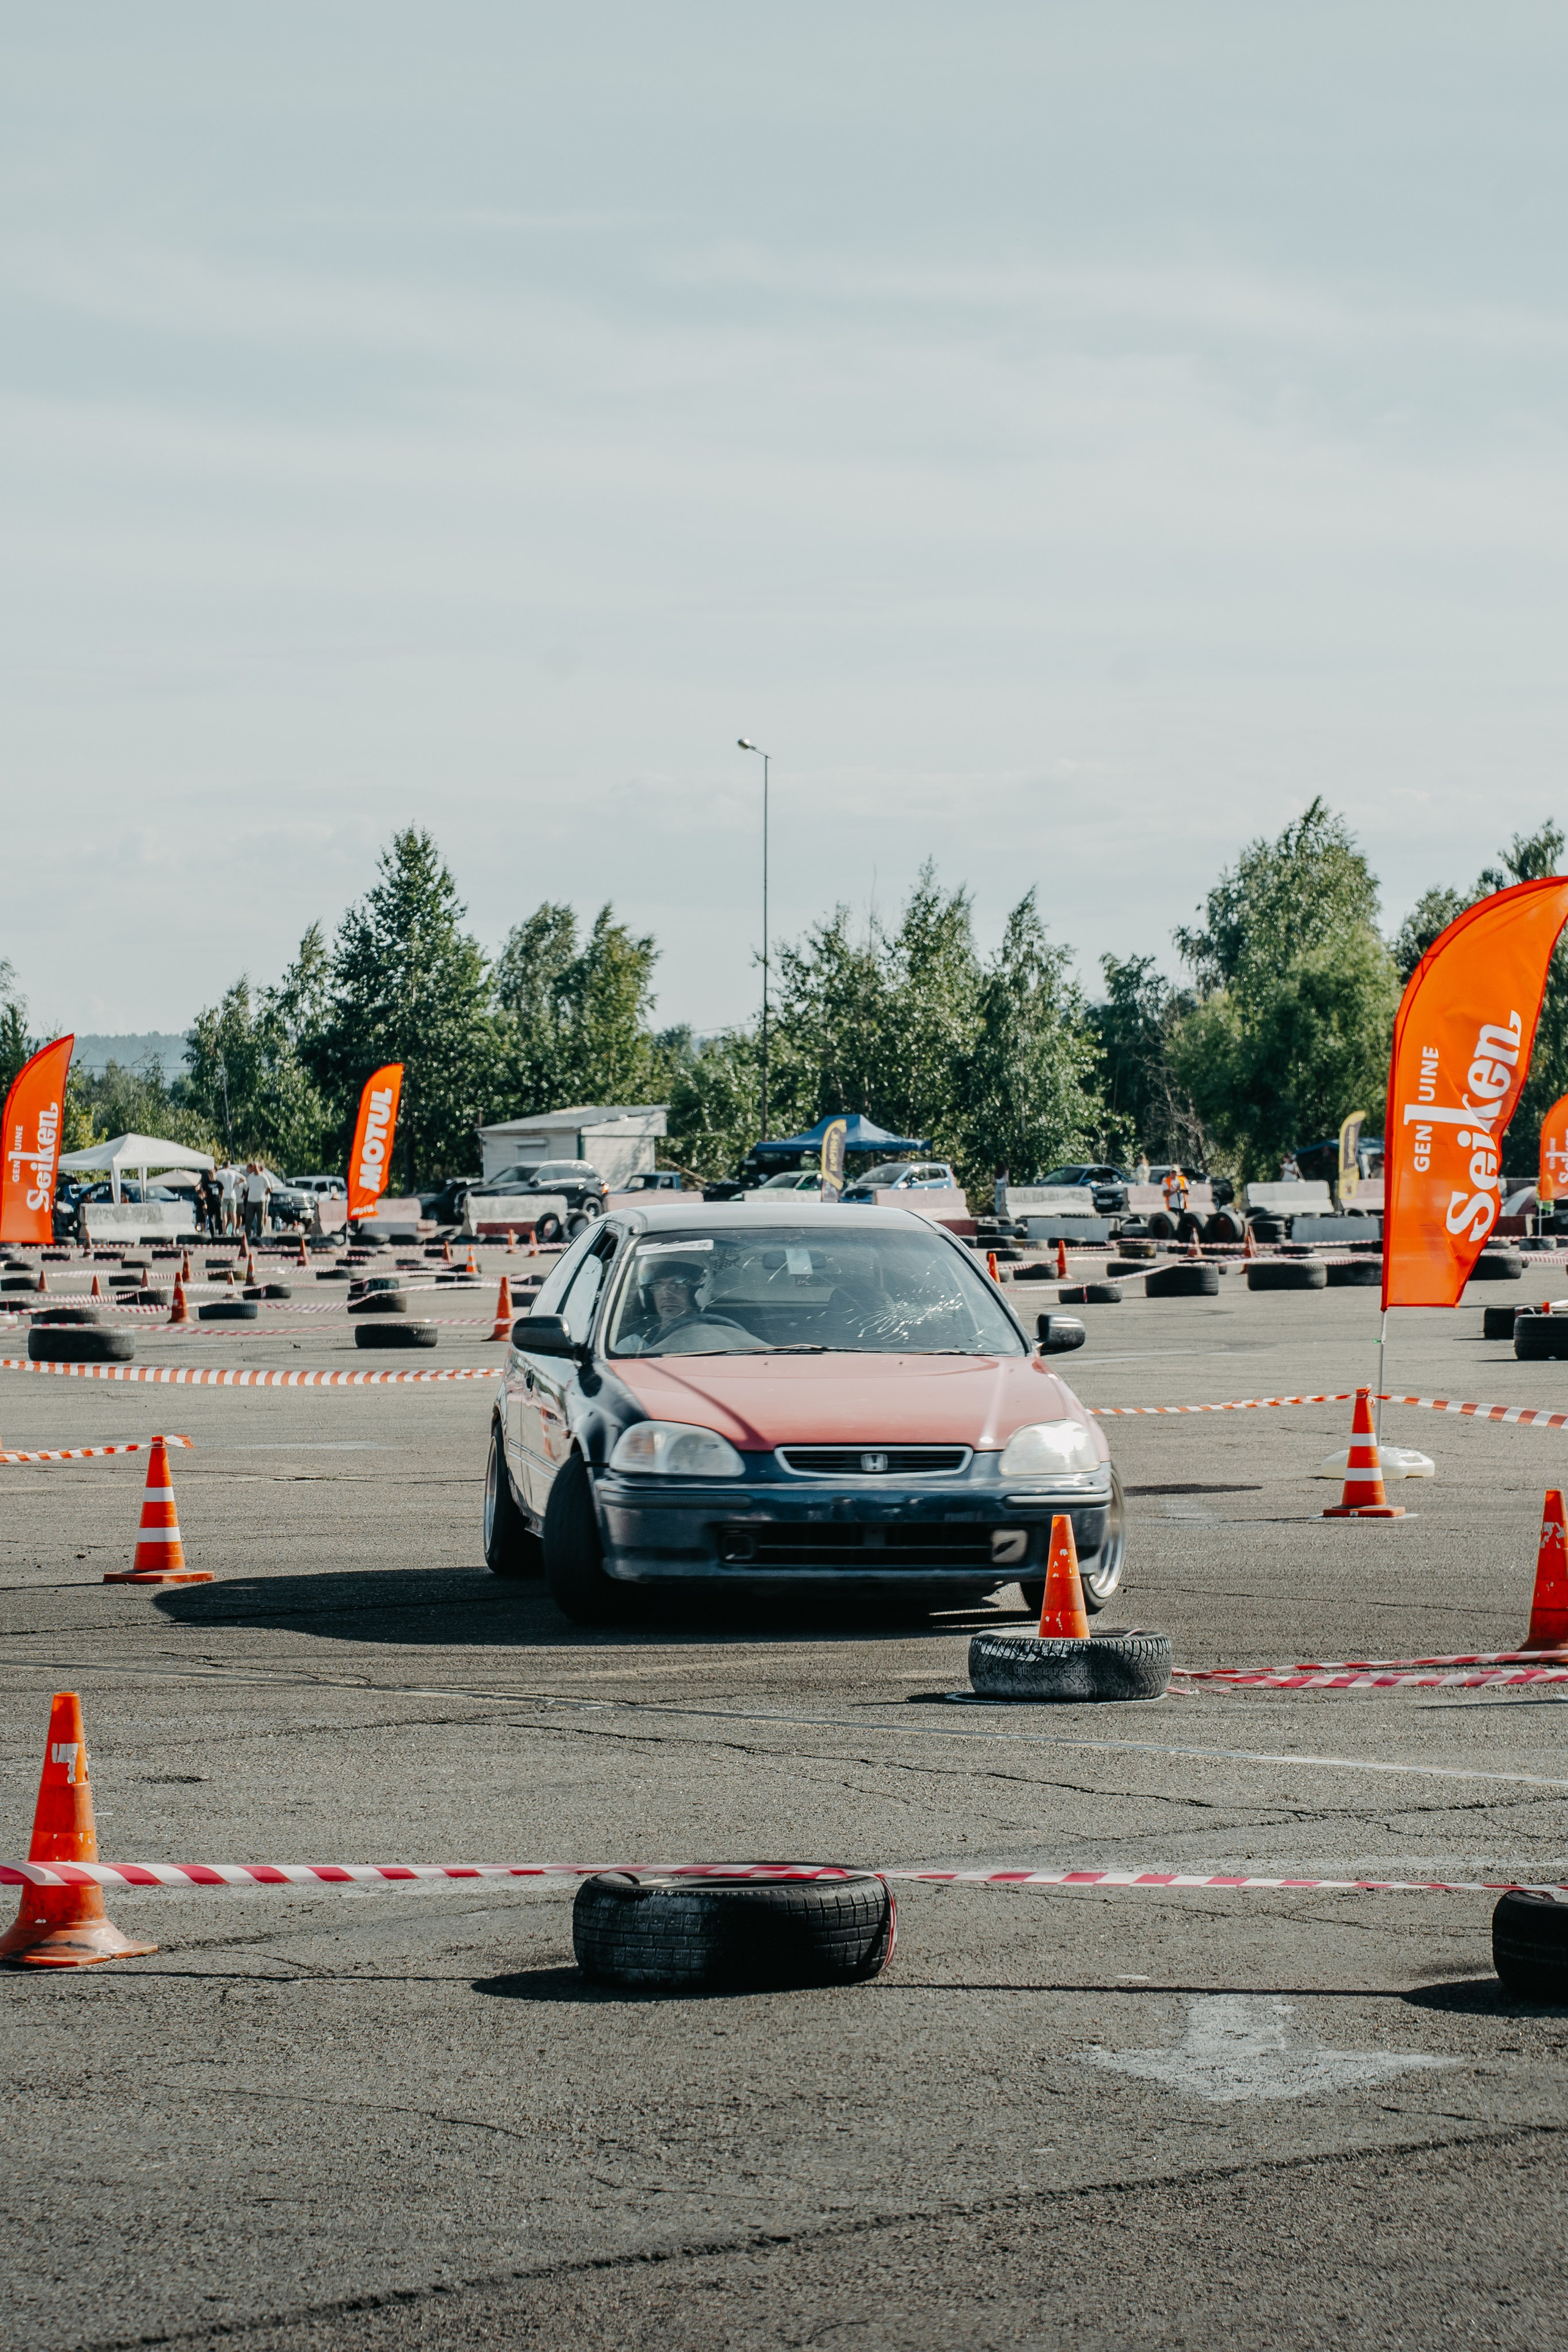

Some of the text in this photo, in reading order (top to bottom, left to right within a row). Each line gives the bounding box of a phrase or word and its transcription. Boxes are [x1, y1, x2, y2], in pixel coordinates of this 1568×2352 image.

[8, 1102, 58, 1213] Seiken
[359, 1087, 393, 1193] MOTUL
[1403, 1010, 1522, 1242] Seiken
